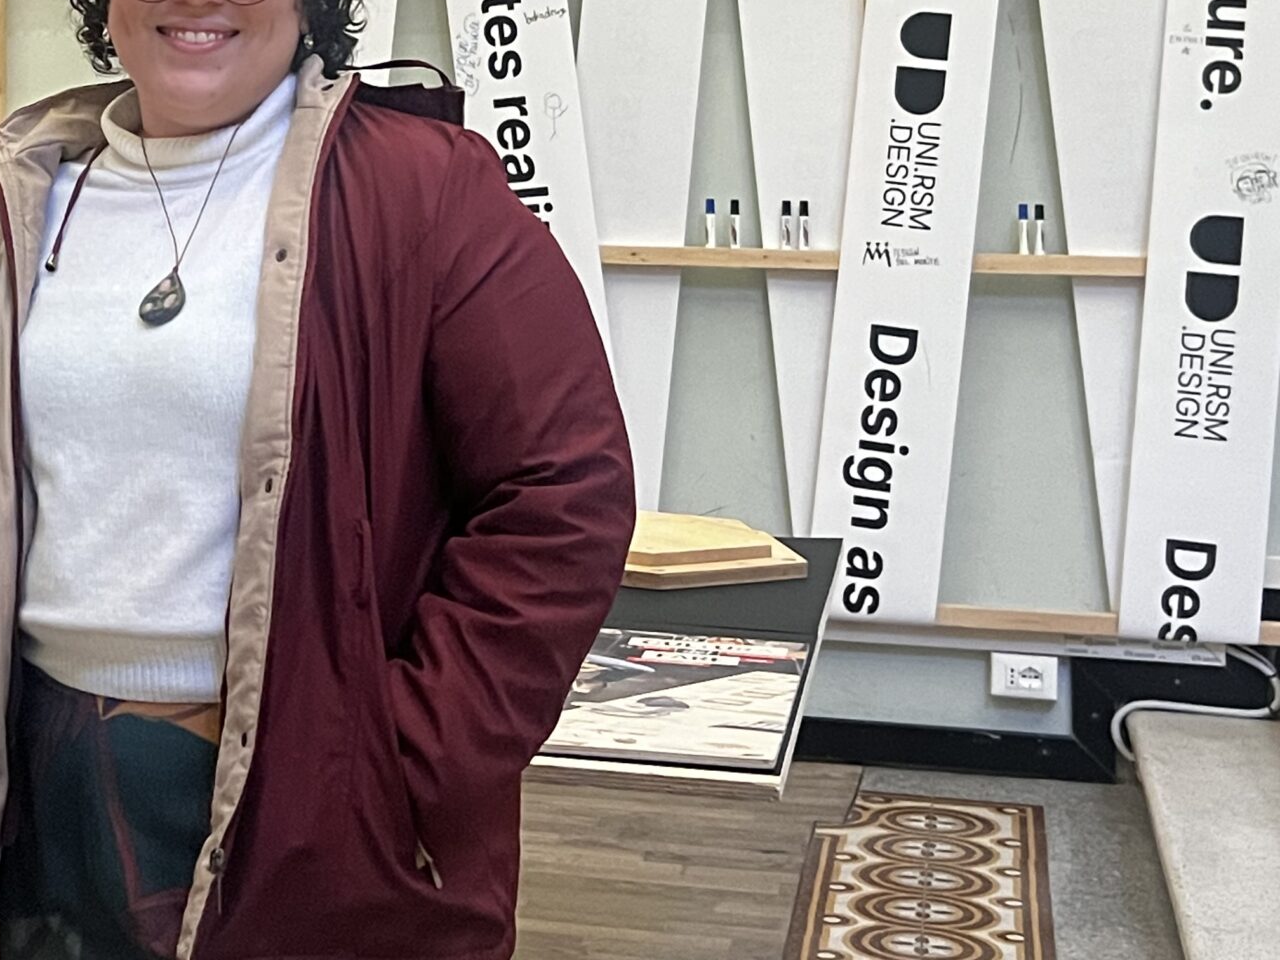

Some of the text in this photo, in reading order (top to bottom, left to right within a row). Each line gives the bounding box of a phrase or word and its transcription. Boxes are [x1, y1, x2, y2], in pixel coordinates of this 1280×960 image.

[880, 118, 913, 228] .DESIGN
[907, 121, 942, 231] UNI.RSM
[1174, 325, 1206, 440] .DESIGN
[1203, 328, 1236, 442] UNI.RSM
[842, 324, 919, 616] Design as
